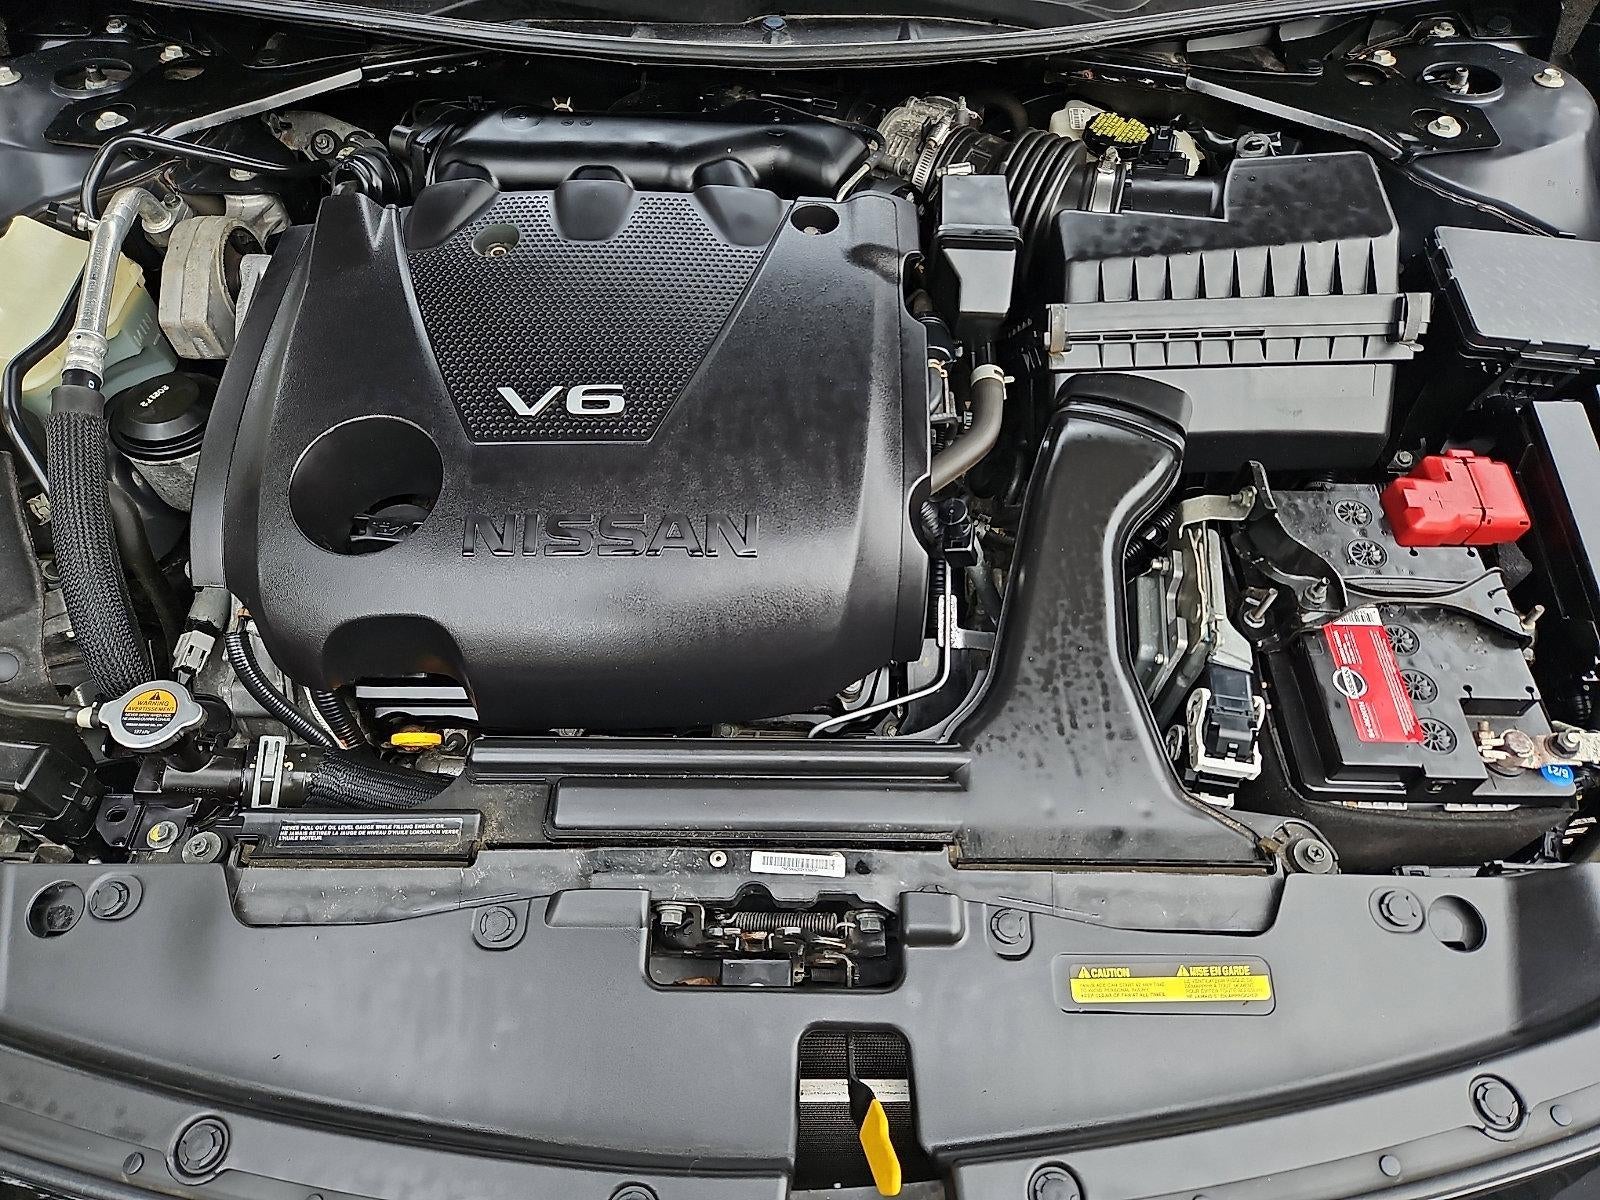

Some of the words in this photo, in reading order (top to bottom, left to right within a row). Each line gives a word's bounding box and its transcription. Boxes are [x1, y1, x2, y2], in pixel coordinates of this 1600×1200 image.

[497, 384, 625, 416] V6
[462, 513, 758, 557] NISSAN
[1090, 967, 1131, 978] CAUTION
[1189, 966, 1210, 977] MISE
[1210, 966, 1222, 976] EN
[1222, 965, 1251, 976] GARDE
